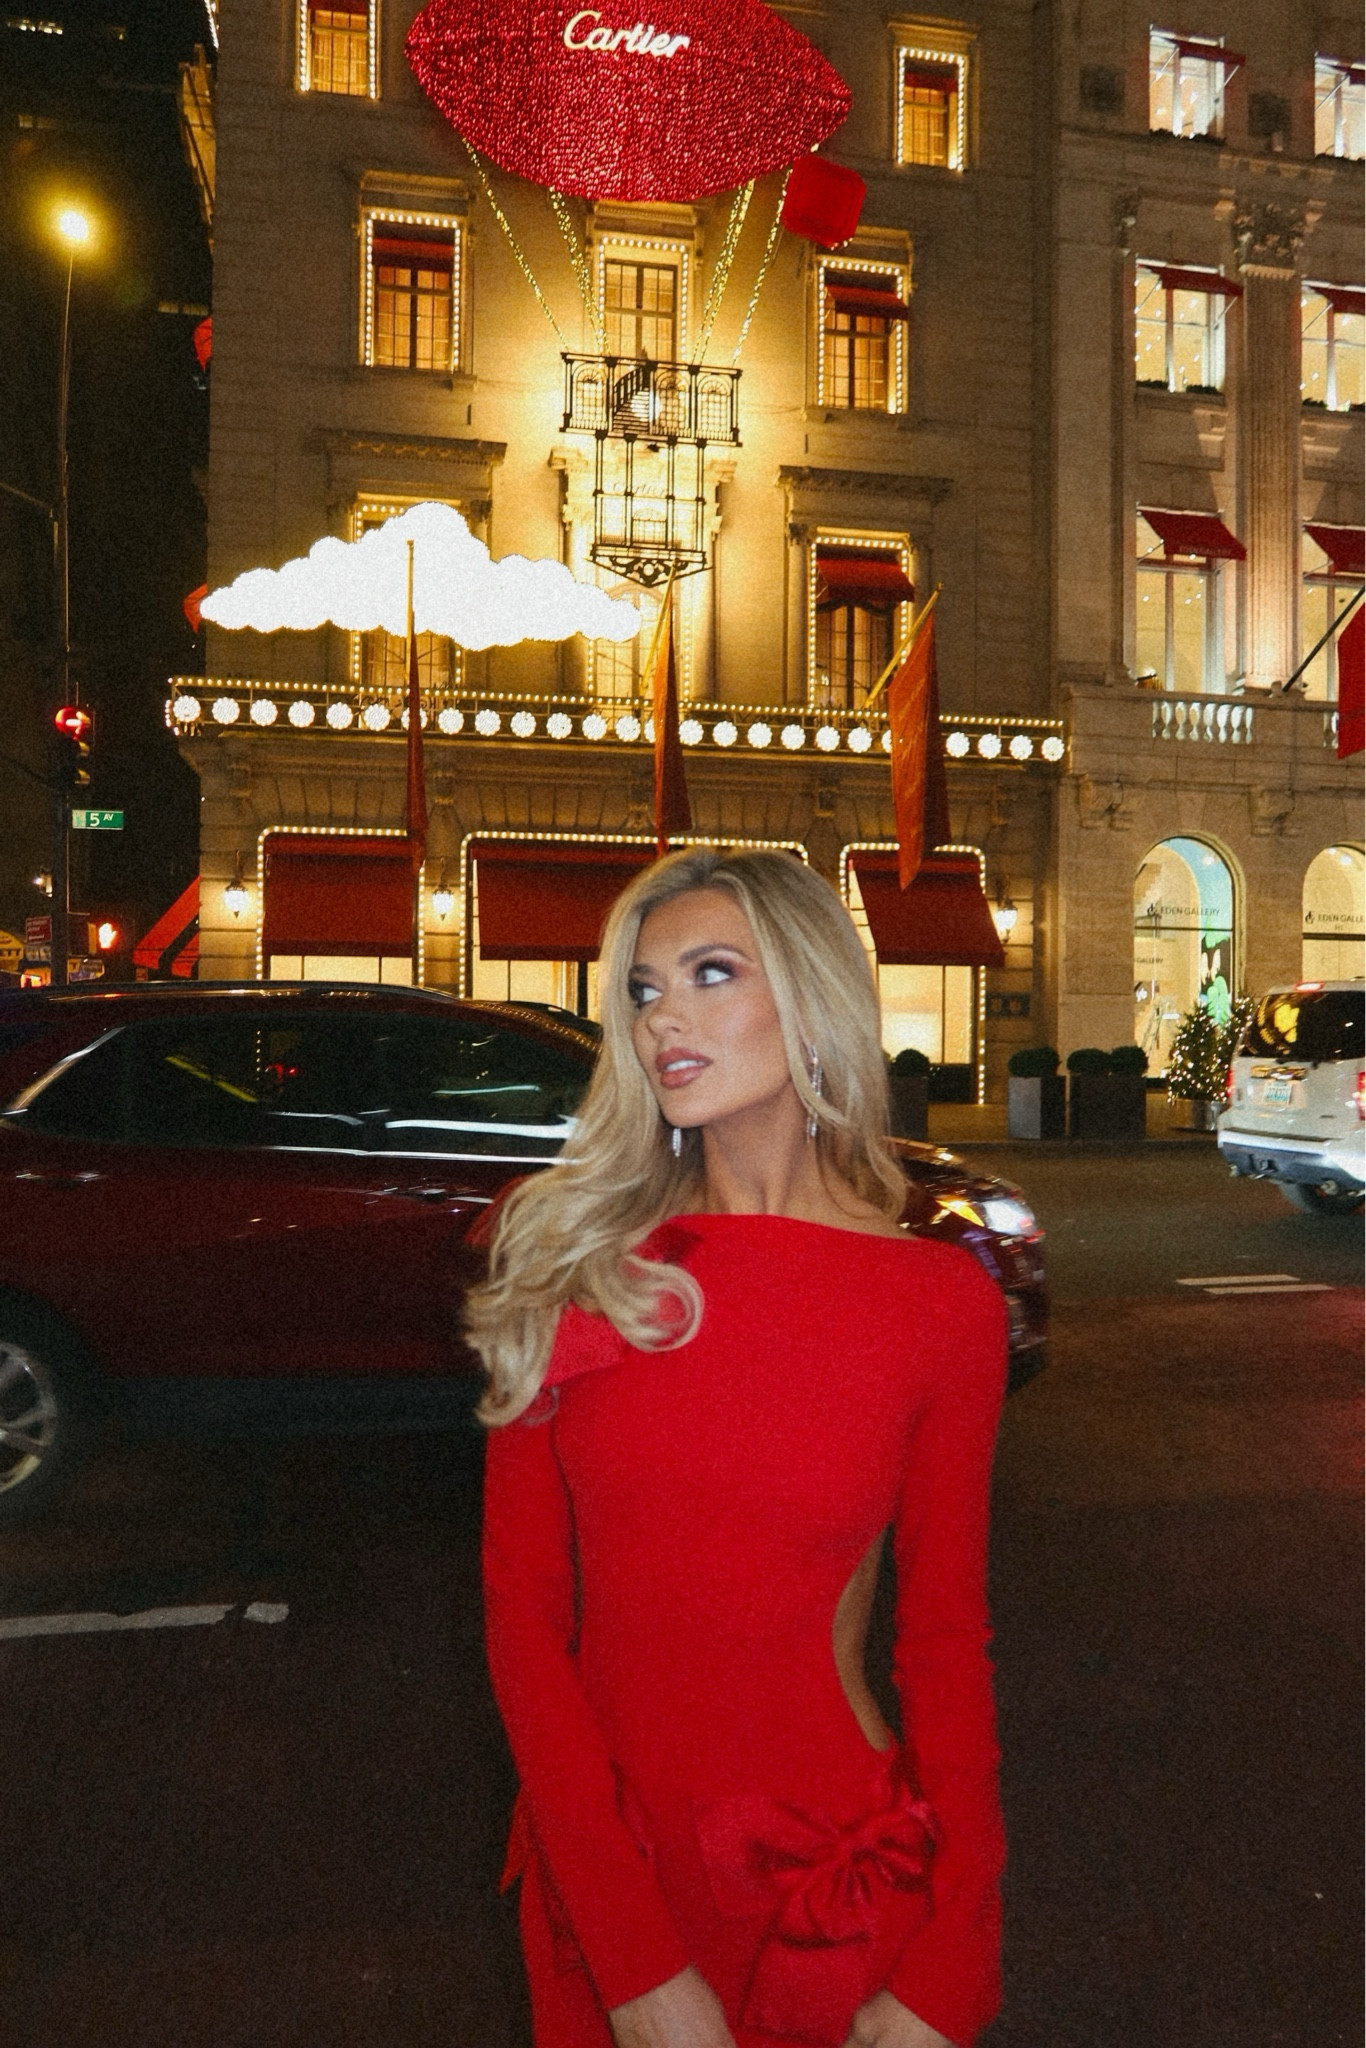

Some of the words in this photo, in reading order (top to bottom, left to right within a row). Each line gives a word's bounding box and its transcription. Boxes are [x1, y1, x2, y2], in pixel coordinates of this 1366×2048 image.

[563, 9, 690, 58] Cartier
[90, 812, 100, 827] 5
[103, 813, 114, 821] AV
[1160, 906, 1183, 915] EDEN
[1184, 906, 1220, 917] GALLERY
[1318, 913, 1339, 922] EDEN
